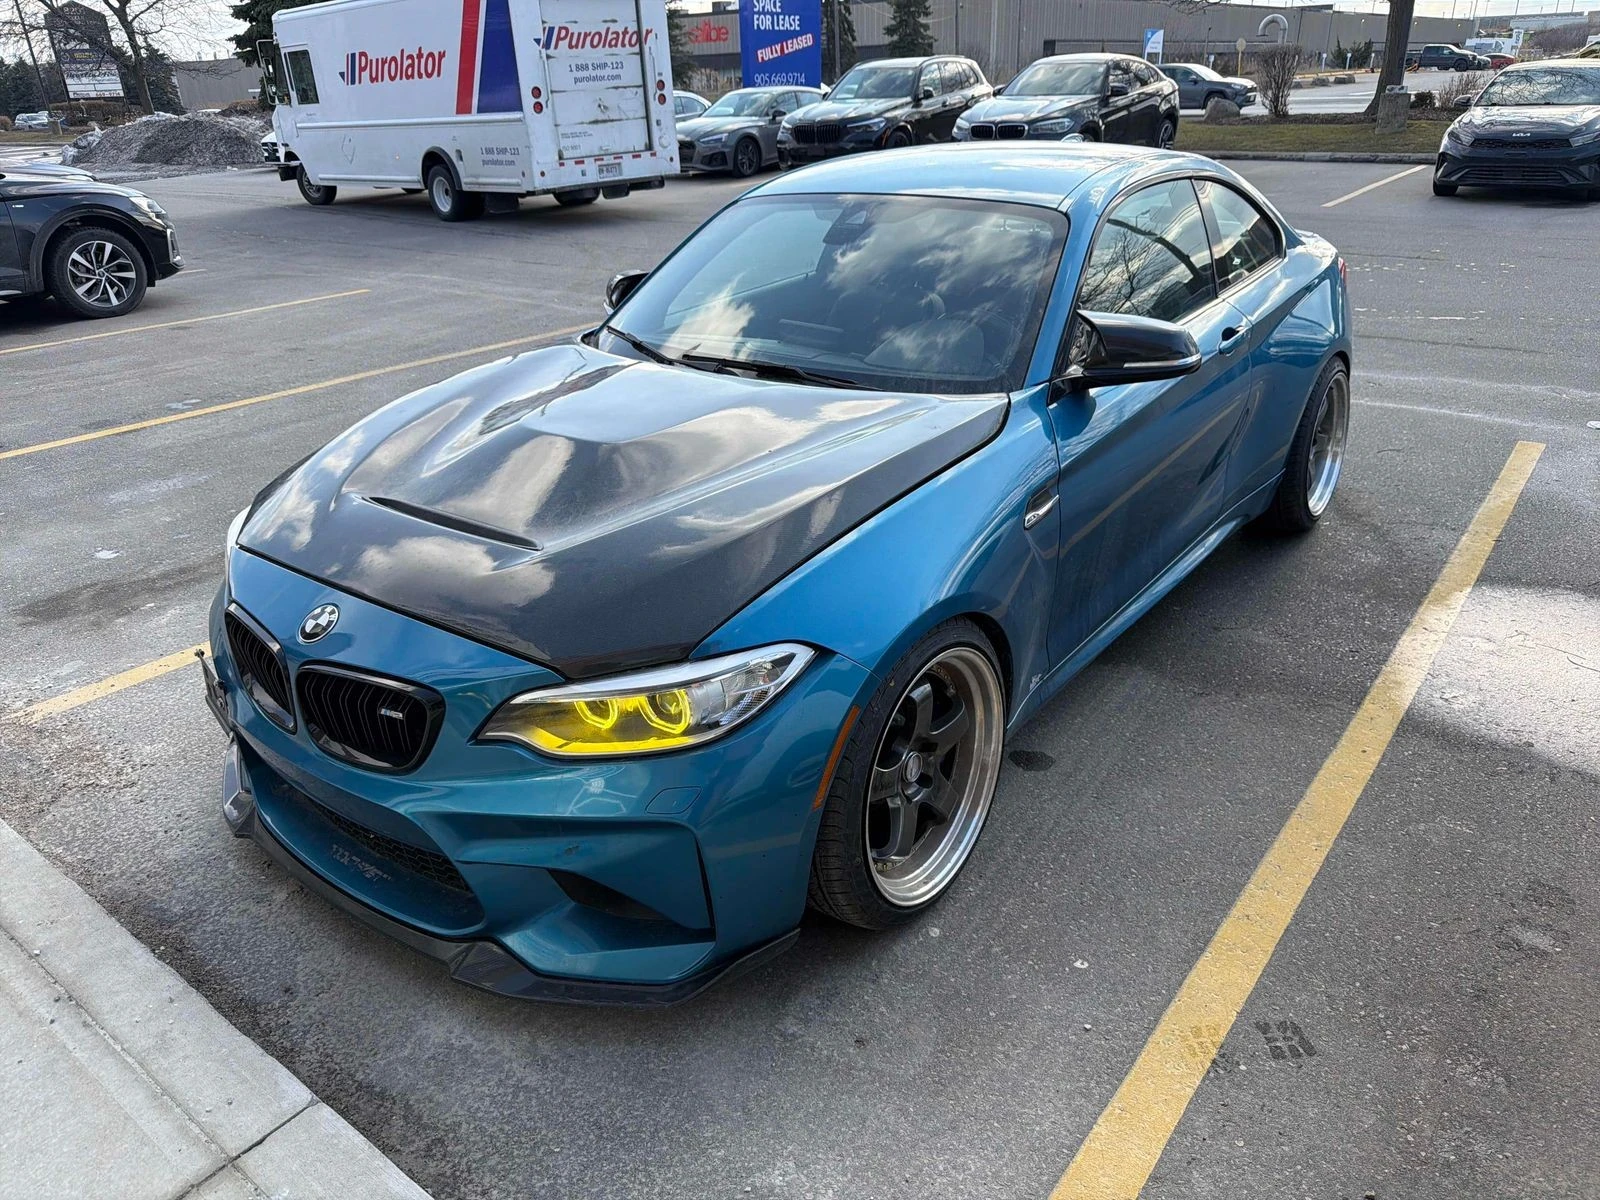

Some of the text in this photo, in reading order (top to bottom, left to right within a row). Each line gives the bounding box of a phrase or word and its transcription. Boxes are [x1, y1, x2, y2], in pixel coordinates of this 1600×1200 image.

[753, 0, 781, 12] SPACE
[754, 15, 800, 31] FOR LEASE
[554, 26, 653, 50] Purolator
[757, 33, 813, 63] FULLY LEASED
[358, 46, 446, 85] Purolator
[568, 61, 624, 73] 1 888 SHIP-123
[573, 73, 622, 85] purolator.com
[754, 72, 806, 87] 905.669.9714
